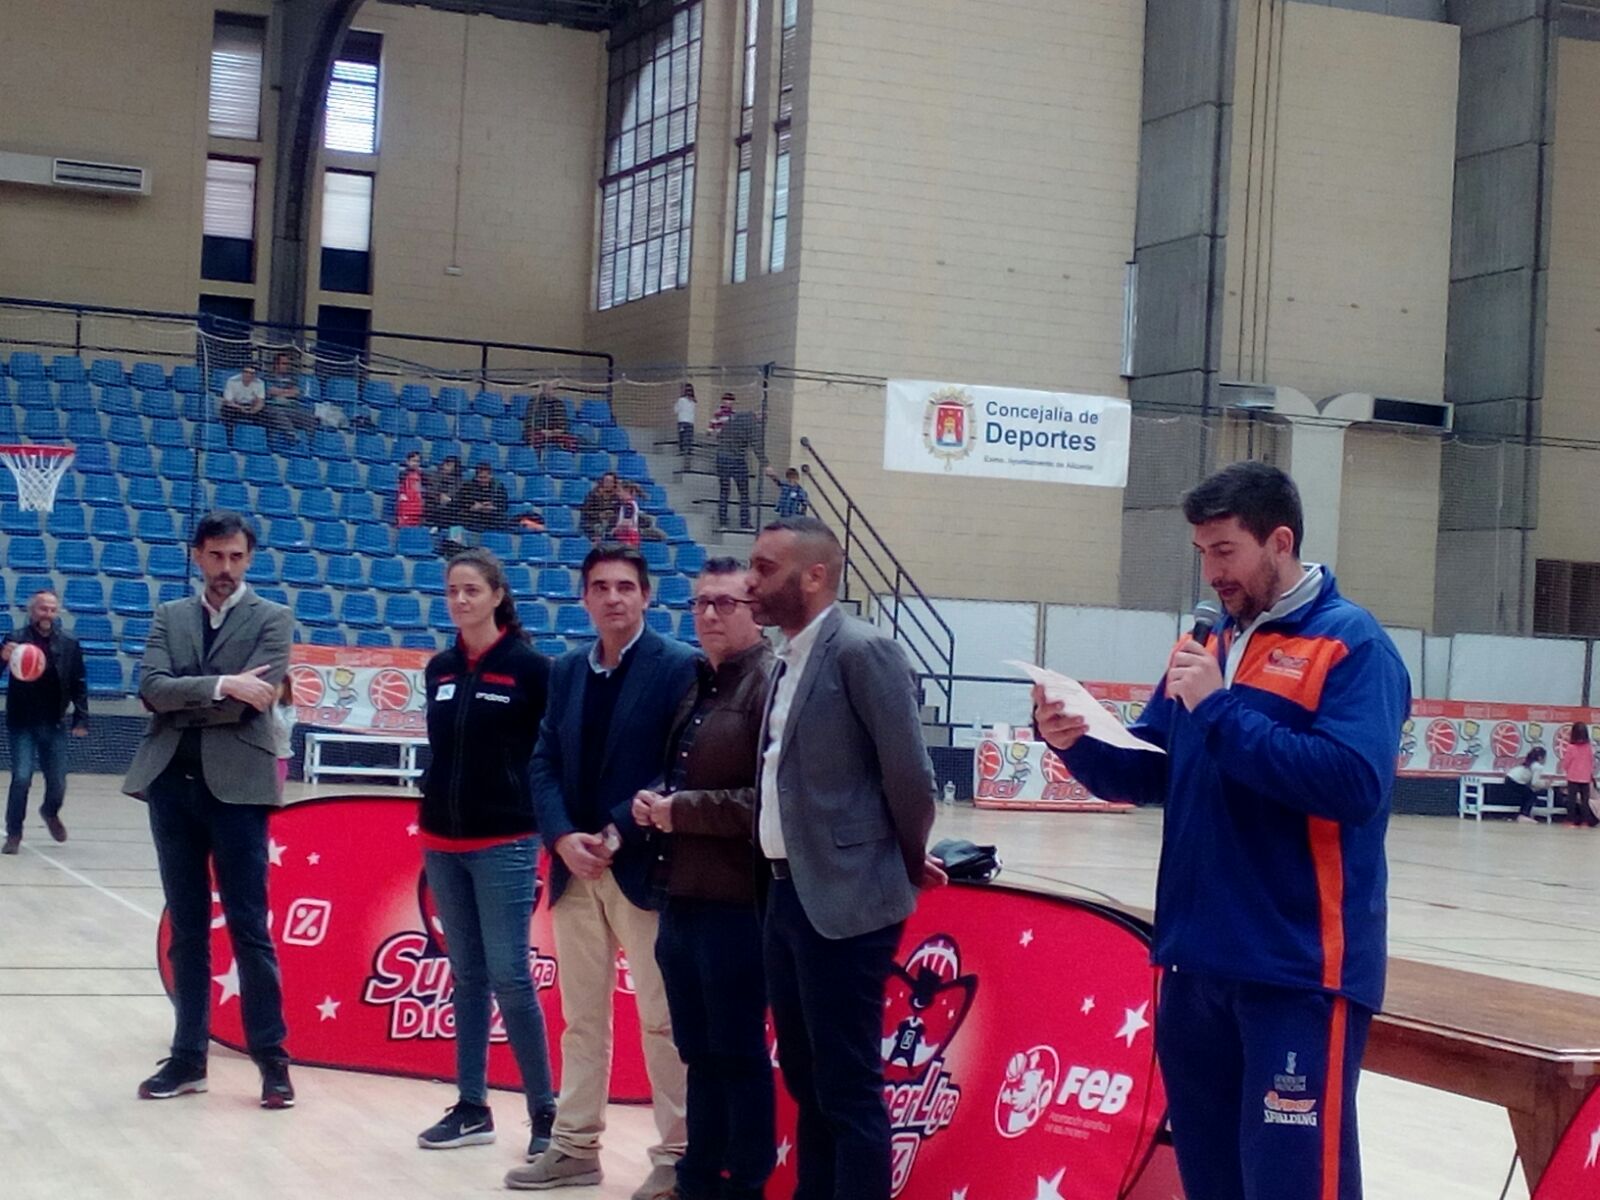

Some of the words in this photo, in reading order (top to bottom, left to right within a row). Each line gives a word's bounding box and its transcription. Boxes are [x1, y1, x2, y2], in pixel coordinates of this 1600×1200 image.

[985, 401, 1073, 424] Concejalía
[1079, 410, 1099, 425] de
[985, 421, 1097, 452] Deportes
